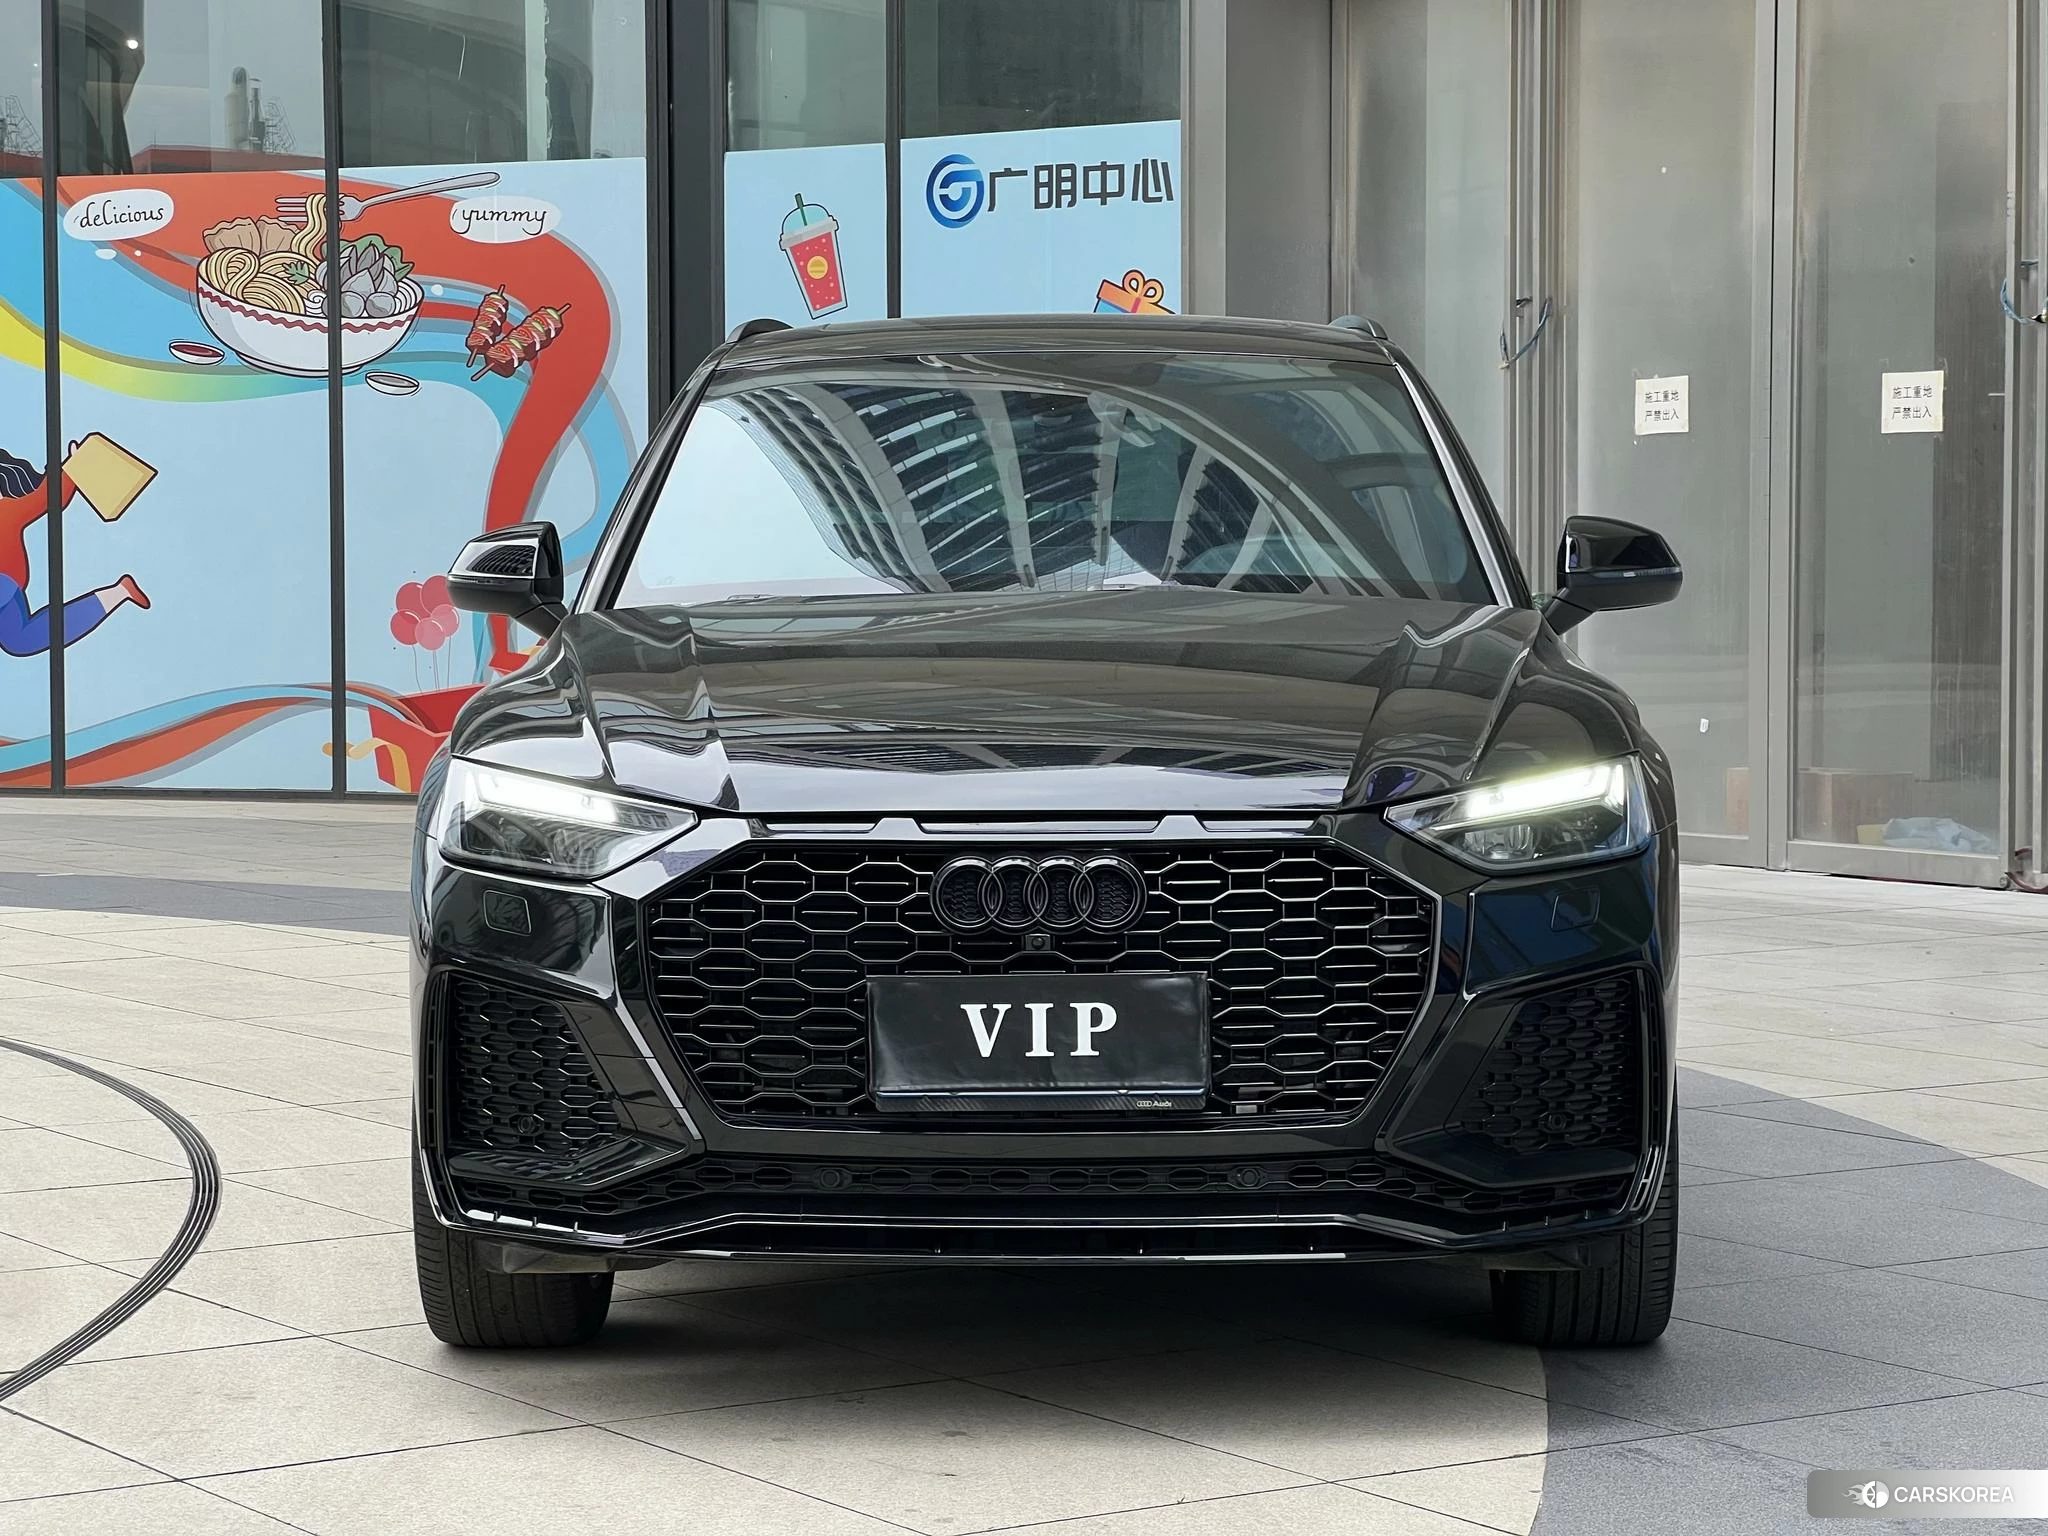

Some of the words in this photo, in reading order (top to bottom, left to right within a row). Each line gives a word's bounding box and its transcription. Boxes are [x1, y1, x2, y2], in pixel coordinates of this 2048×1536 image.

[987, 158, 1175, 212] 广明中心
[79, 199, 165, 228] delicious
[450, 209, 547, 236] yummy
[1644, 390, 1680, 403] 施工重地
[1892, 385, 1933, 399] 施工重地
[1644, 408, 1680, 422] 严禁出入
[1891, 406, 1932, 420] 严禁出入
[960, 1002, 1117, 1058] VIP
